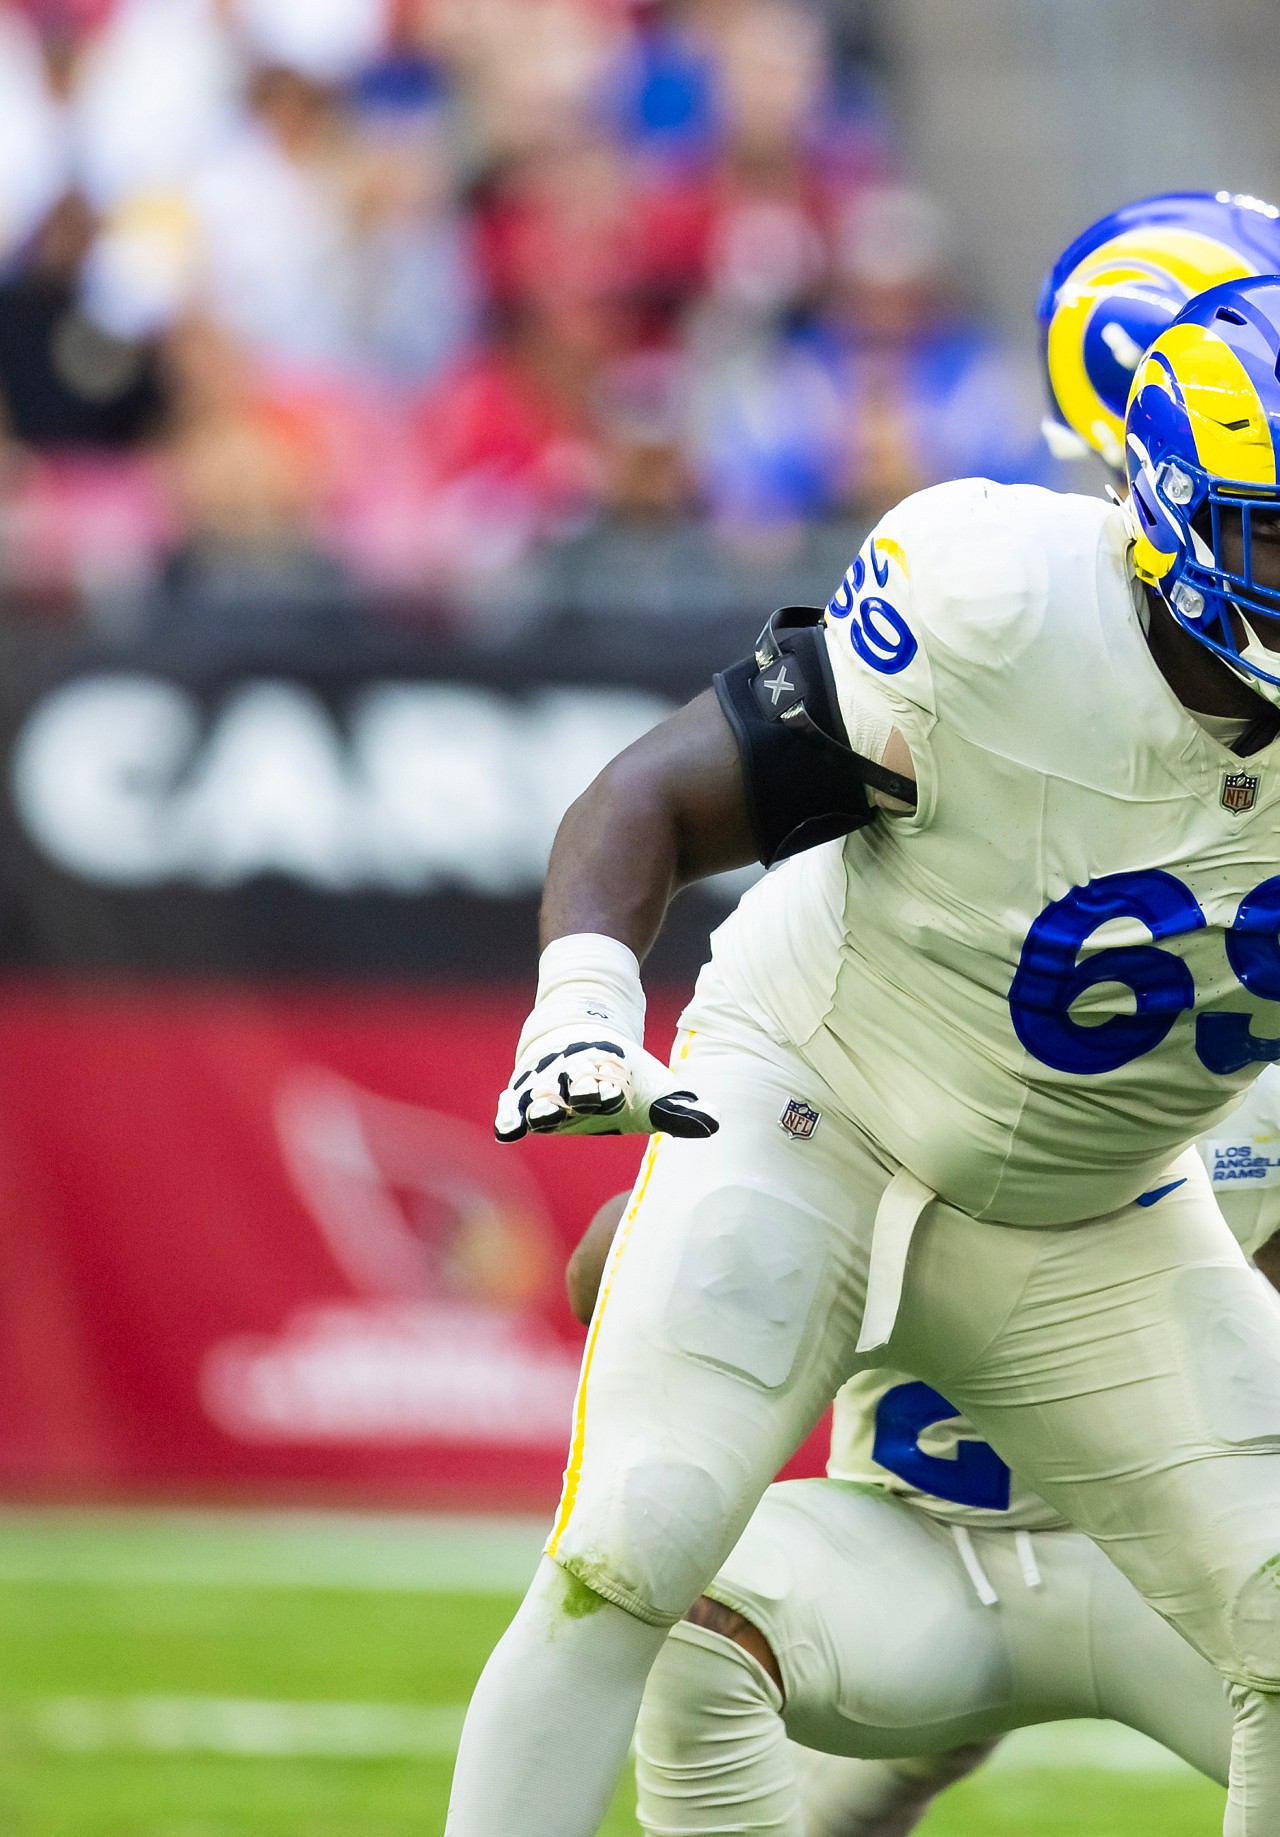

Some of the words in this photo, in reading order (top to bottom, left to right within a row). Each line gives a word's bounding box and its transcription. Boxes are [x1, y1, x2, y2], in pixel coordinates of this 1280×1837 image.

[1225, 788, 1251, 808] NFL
[785, 1111, 811, 1134] NFL
[1214, 1146, 1252, 1159] LOS
[1213, 1168, 1267, 1181] RAMS
